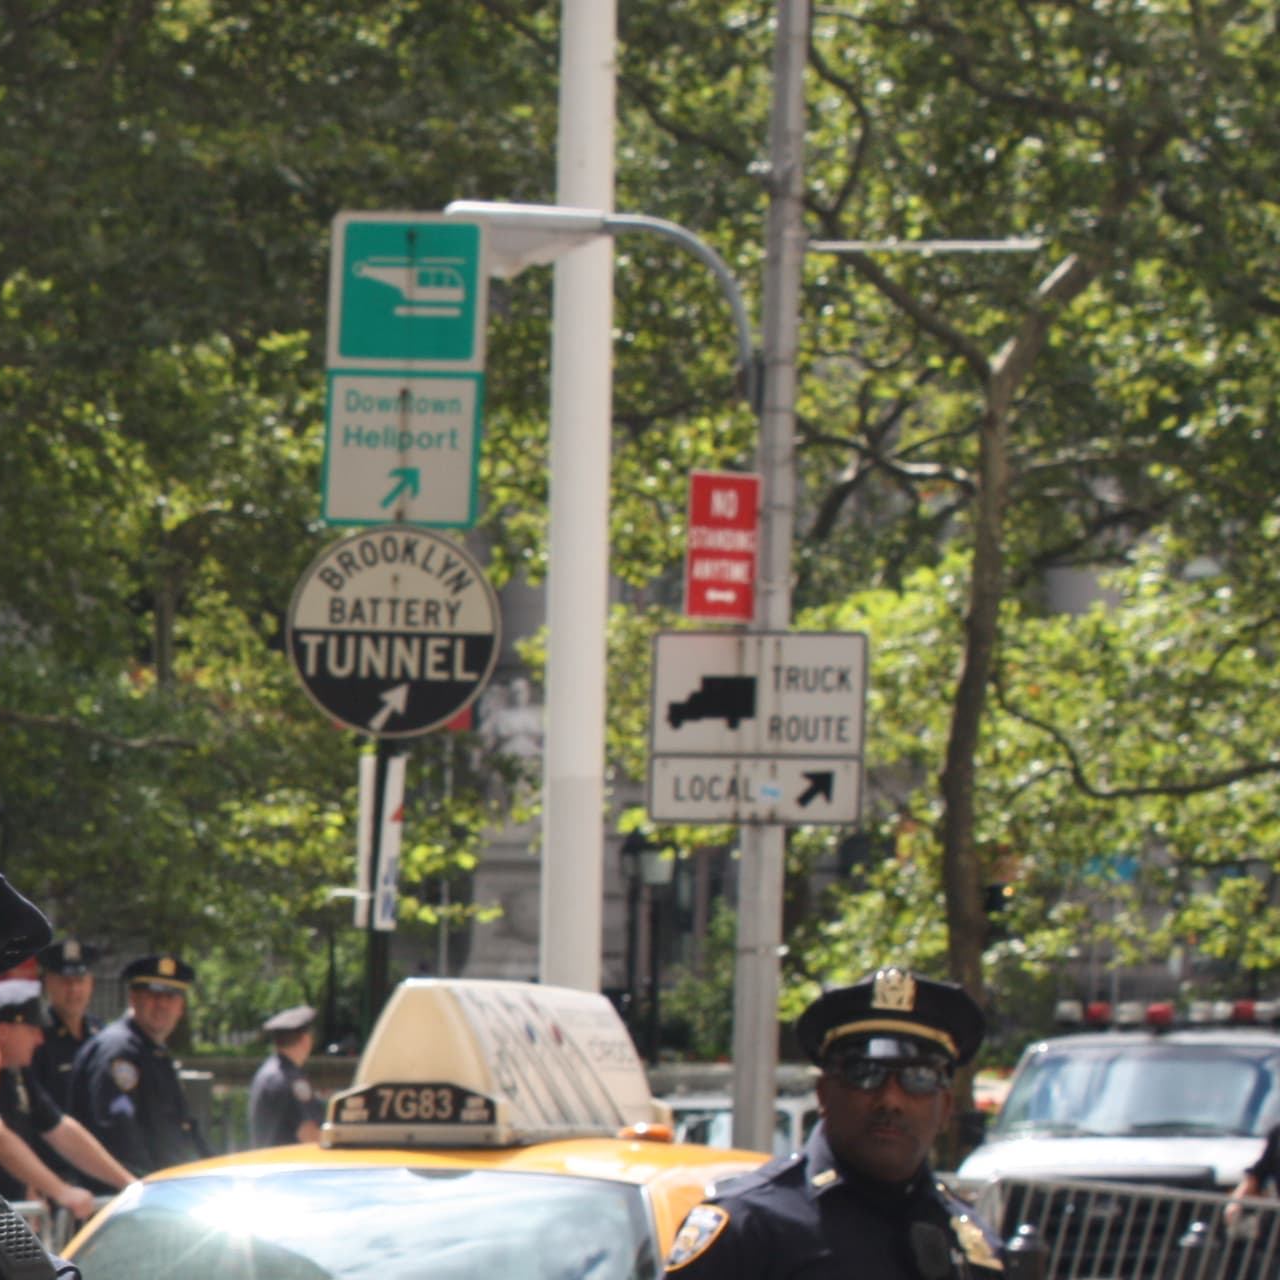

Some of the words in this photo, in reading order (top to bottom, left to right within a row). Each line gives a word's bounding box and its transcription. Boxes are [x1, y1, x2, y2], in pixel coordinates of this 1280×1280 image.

[345, 388, 462, 415] Downtown
[343, 425, 459, 453] Heliport
[711, 487, 739, 519] NO
[318, 535, 475, 595] BROOKLYN
[329, 597, 462, 627] BATTERY
[299, 633, 480, 682] TUNNEL
[771, 665, 853, 693] TRUCK
[767, 715, 851, 744] ROUTE
[673, 775, 757, 802] LOCAL
[376, 1087, 455, 1120] 7G83
